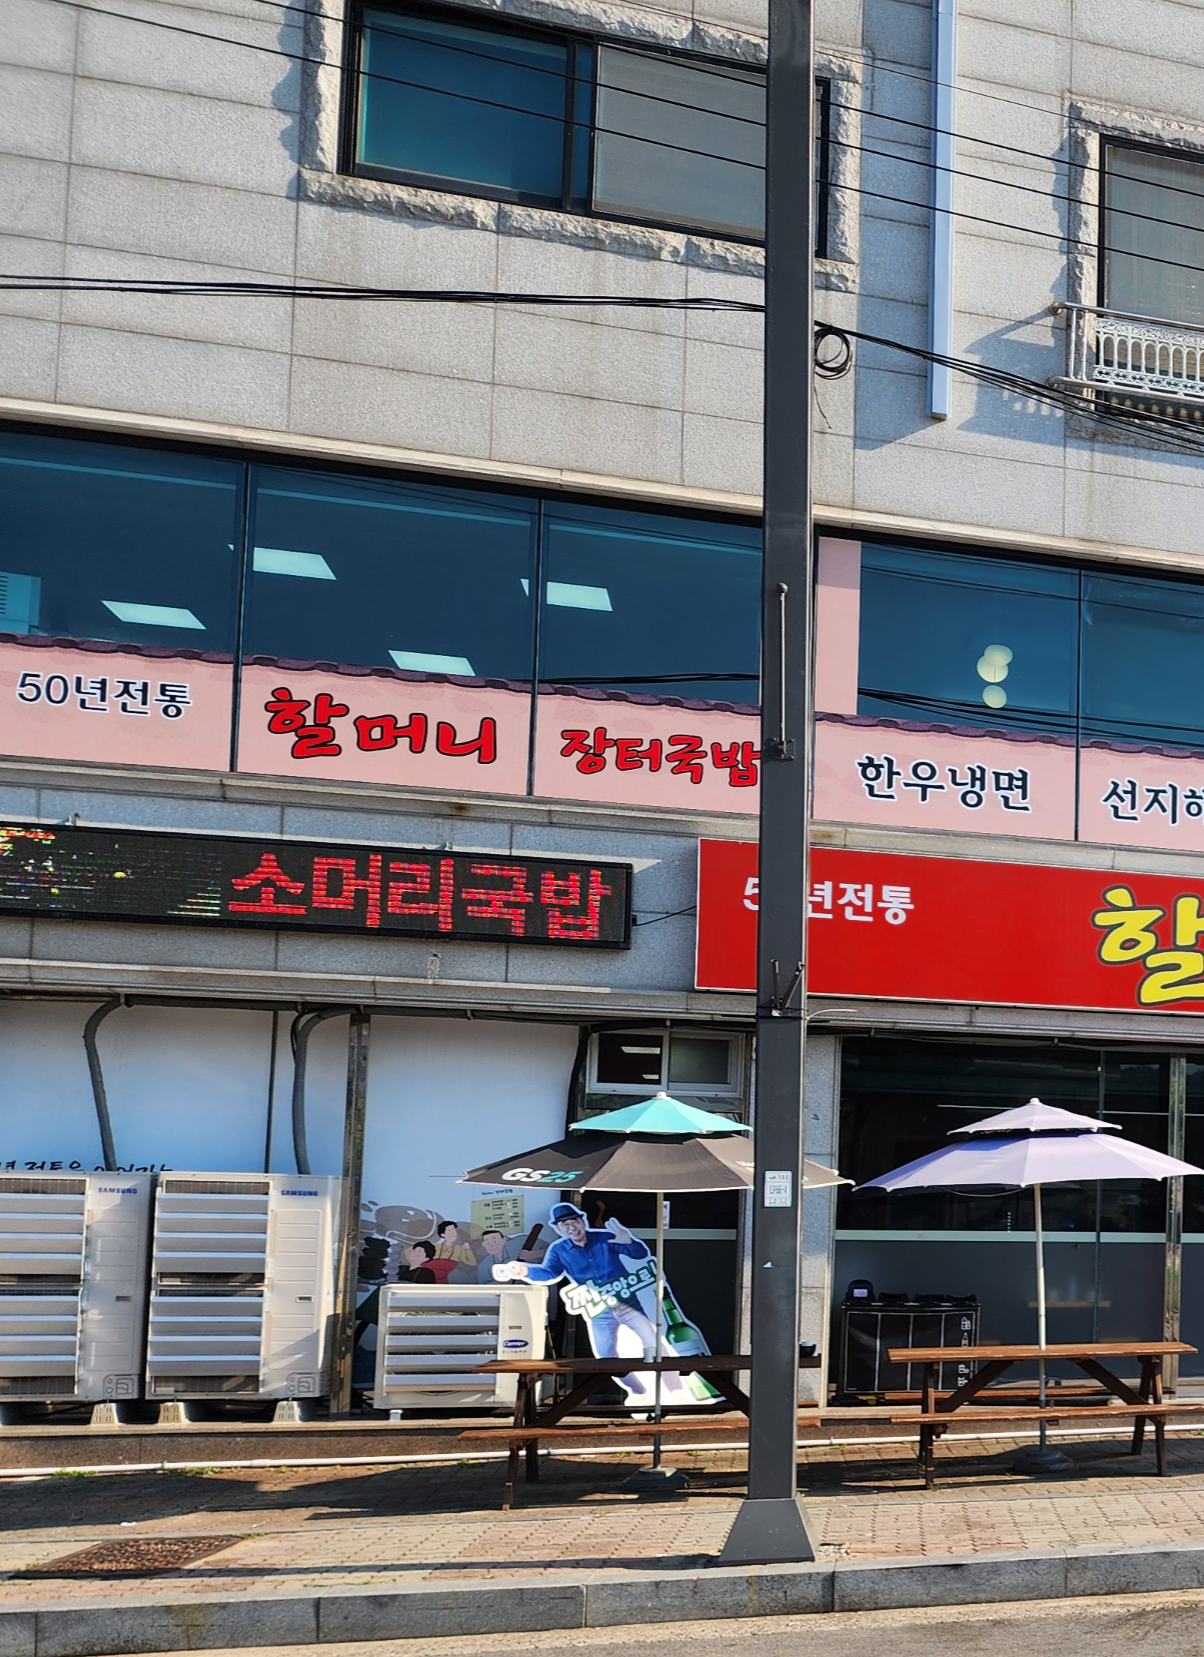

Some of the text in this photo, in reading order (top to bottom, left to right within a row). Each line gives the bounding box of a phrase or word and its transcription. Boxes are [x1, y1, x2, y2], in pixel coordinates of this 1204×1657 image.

[17, 671, 192, 720] 50년전통
[265, 687, 761, 787] 할머니 장터국밥
[856, 754, 1032, 812] 한우냉면
[228, 852, 611, 940] 소머리국밥
[743, 877, 914, 925] 5년전통
[280, 1189, 319, 1197] SAMSUNG
[501, 1168, 584, 1183] GS25
